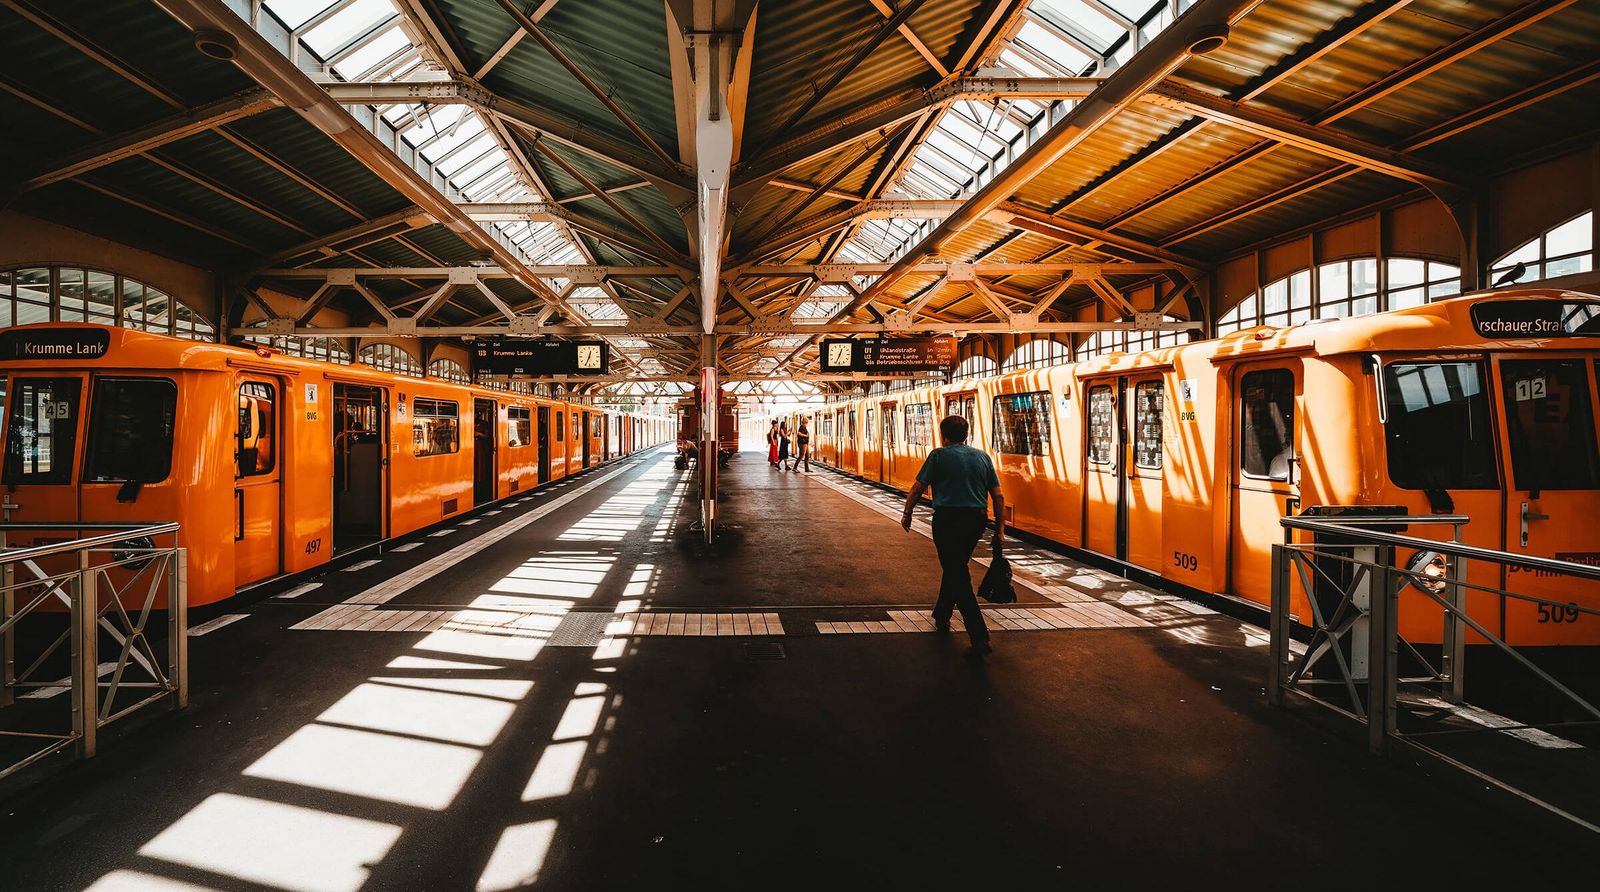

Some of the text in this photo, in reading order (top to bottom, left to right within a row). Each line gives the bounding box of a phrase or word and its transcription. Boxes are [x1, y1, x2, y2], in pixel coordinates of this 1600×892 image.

[1480, 318, 1563, 332] rschauer Stra
[24, 342, 73, 354] Krumme
[306, 411, 317, 420] BVG
[1181, 411, 1195, 421] BVG
[305, 537, 321, 554] 497
[1174, 551, 1198, 571] 509
[1537, 601, 1579, 624] 509
